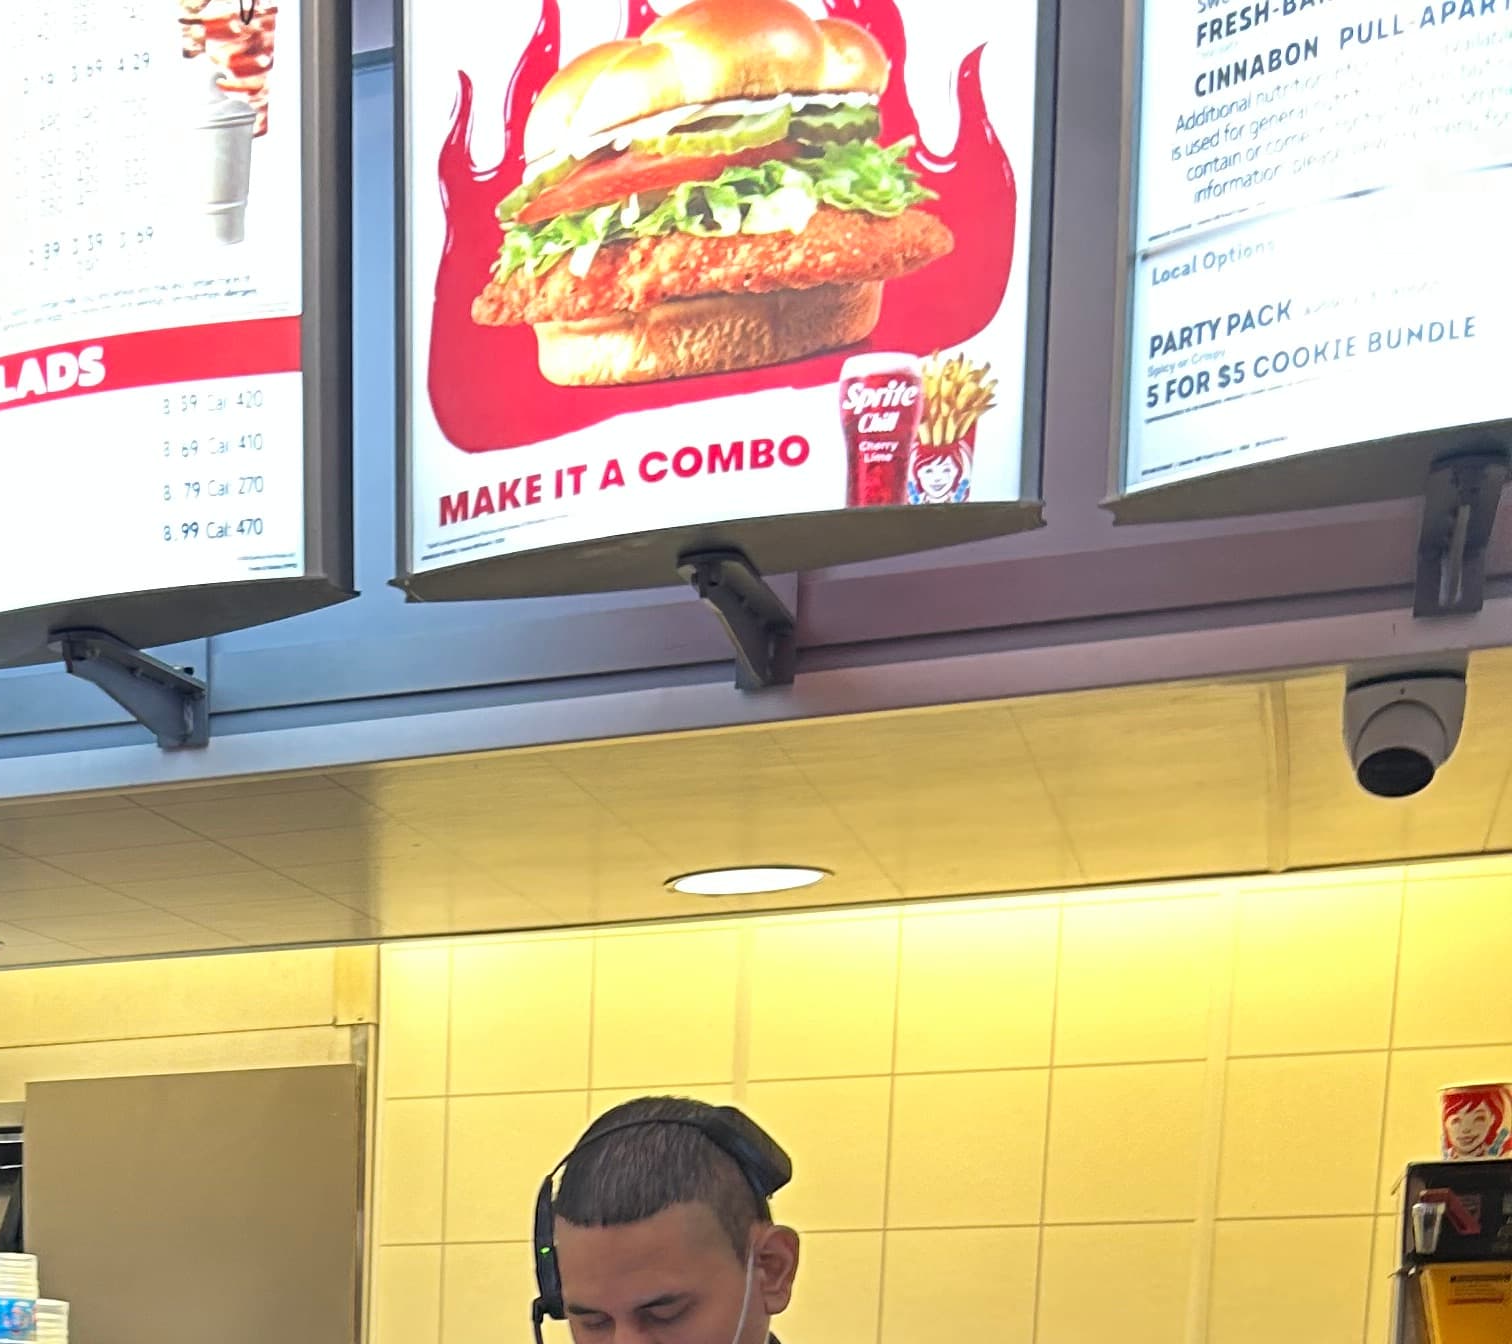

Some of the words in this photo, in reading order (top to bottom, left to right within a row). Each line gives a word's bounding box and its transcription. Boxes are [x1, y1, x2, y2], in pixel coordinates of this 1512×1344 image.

[1195, 36, 1319, 98] CINNABON
[1176, 90, 1251, 133] Additional
[1186, 128, 1220, 157] used
[1224, 122, 1246, 142] for
[1187, 151, 1241, 182] contain
[1152, 251, 1197, 286] Local
[1149, 316, 1222, 360] PARTY
[1226, 298, 1292, 337] PACK
[1146, 383, 1159, 409] 5
[1165, 370, 1210, 404] FOR
[1217, 361, 1245, 389] $5
[1253, 336, 1358, 378] COOKIE
[1368, 315, 1477, 353] BUNDLE
[841, 379, 919, 415] Sprite
[857, 411, 900, 434] Chill
[438, 473, 542, 527] MAKE
[554, 464, 588, 499] IT
[599, 458, 626, 491] A
[637, 433, 811, 484] COMBO
